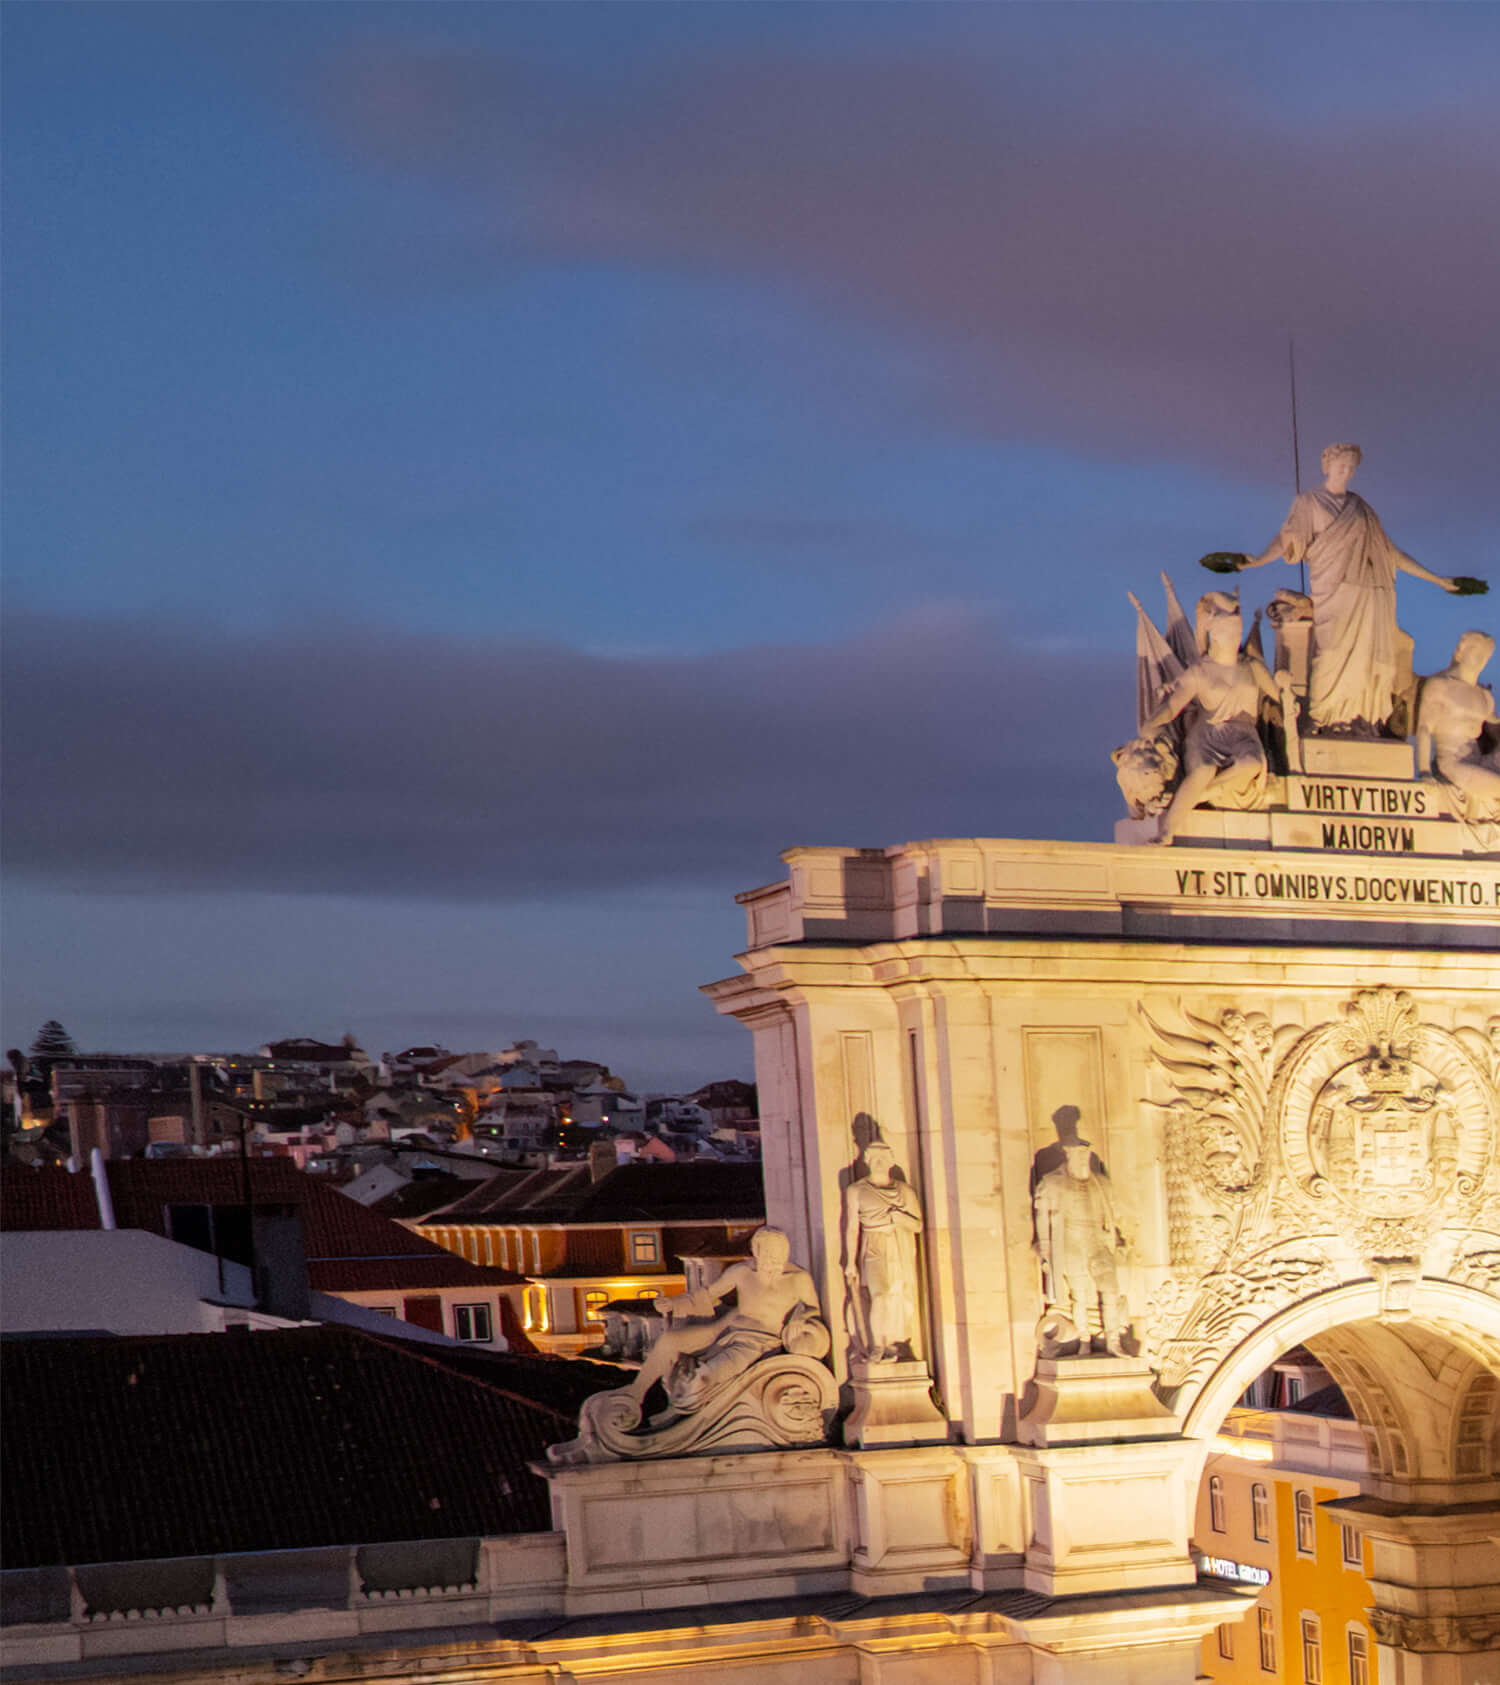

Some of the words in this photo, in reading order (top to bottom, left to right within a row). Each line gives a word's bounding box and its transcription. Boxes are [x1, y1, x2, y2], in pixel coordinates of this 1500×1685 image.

[1300, 784, 1426, 814] VIRTVTIBVS
[1321, 823, 1415, 851] MAIORVM
[1211, 1558, 1240, 1579] HOTEL
